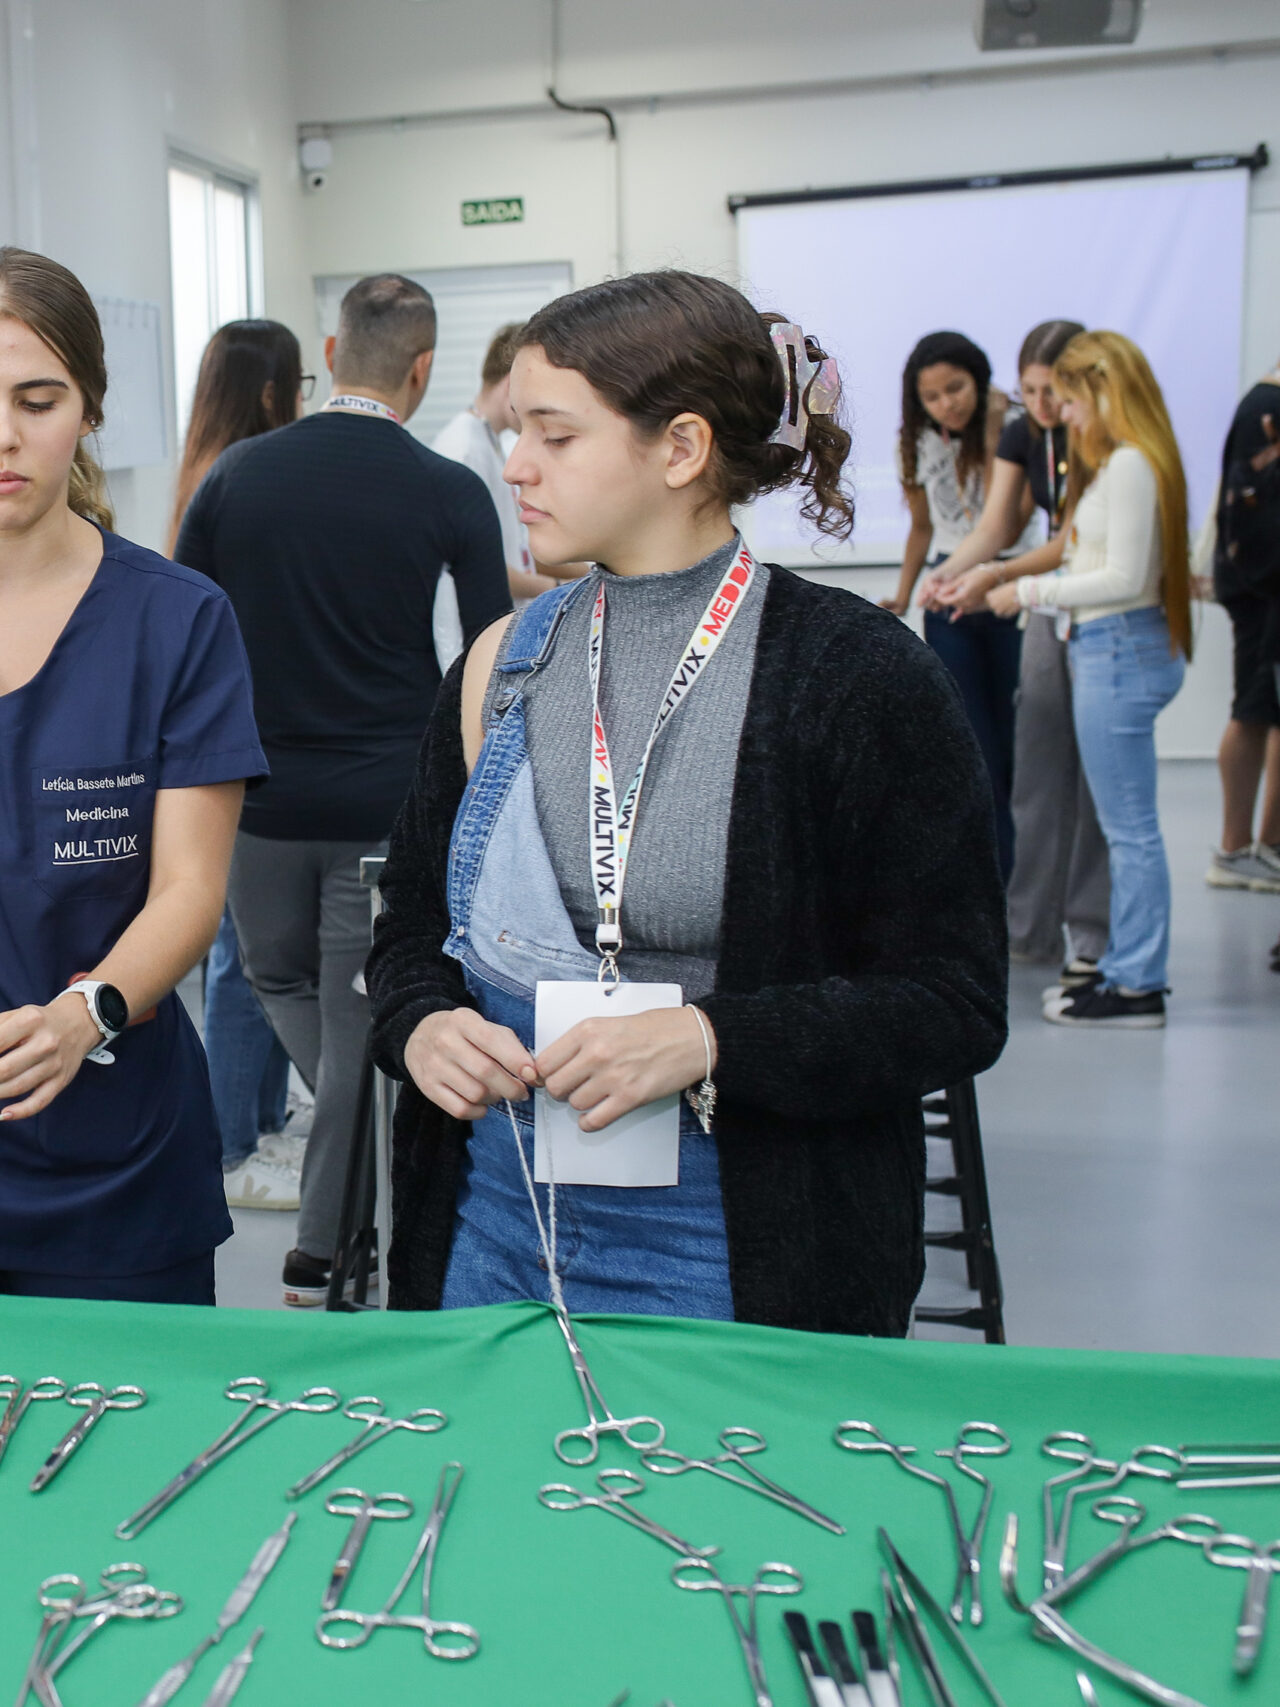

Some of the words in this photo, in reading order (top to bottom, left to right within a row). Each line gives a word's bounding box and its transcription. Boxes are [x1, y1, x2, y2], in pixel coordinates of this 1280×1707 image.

[654, 647, 706, 733] LTIVIX
[42, 776, 75, 792] Letícia
[77, 777, 116, 791] Bassete
[116, 772, 145, 788] Martins
[66, 806, 129, 822] Medicina
[54, 834, 138, 860] MULTIVIX
[594, 785, 616, 897] MULTIVIX
